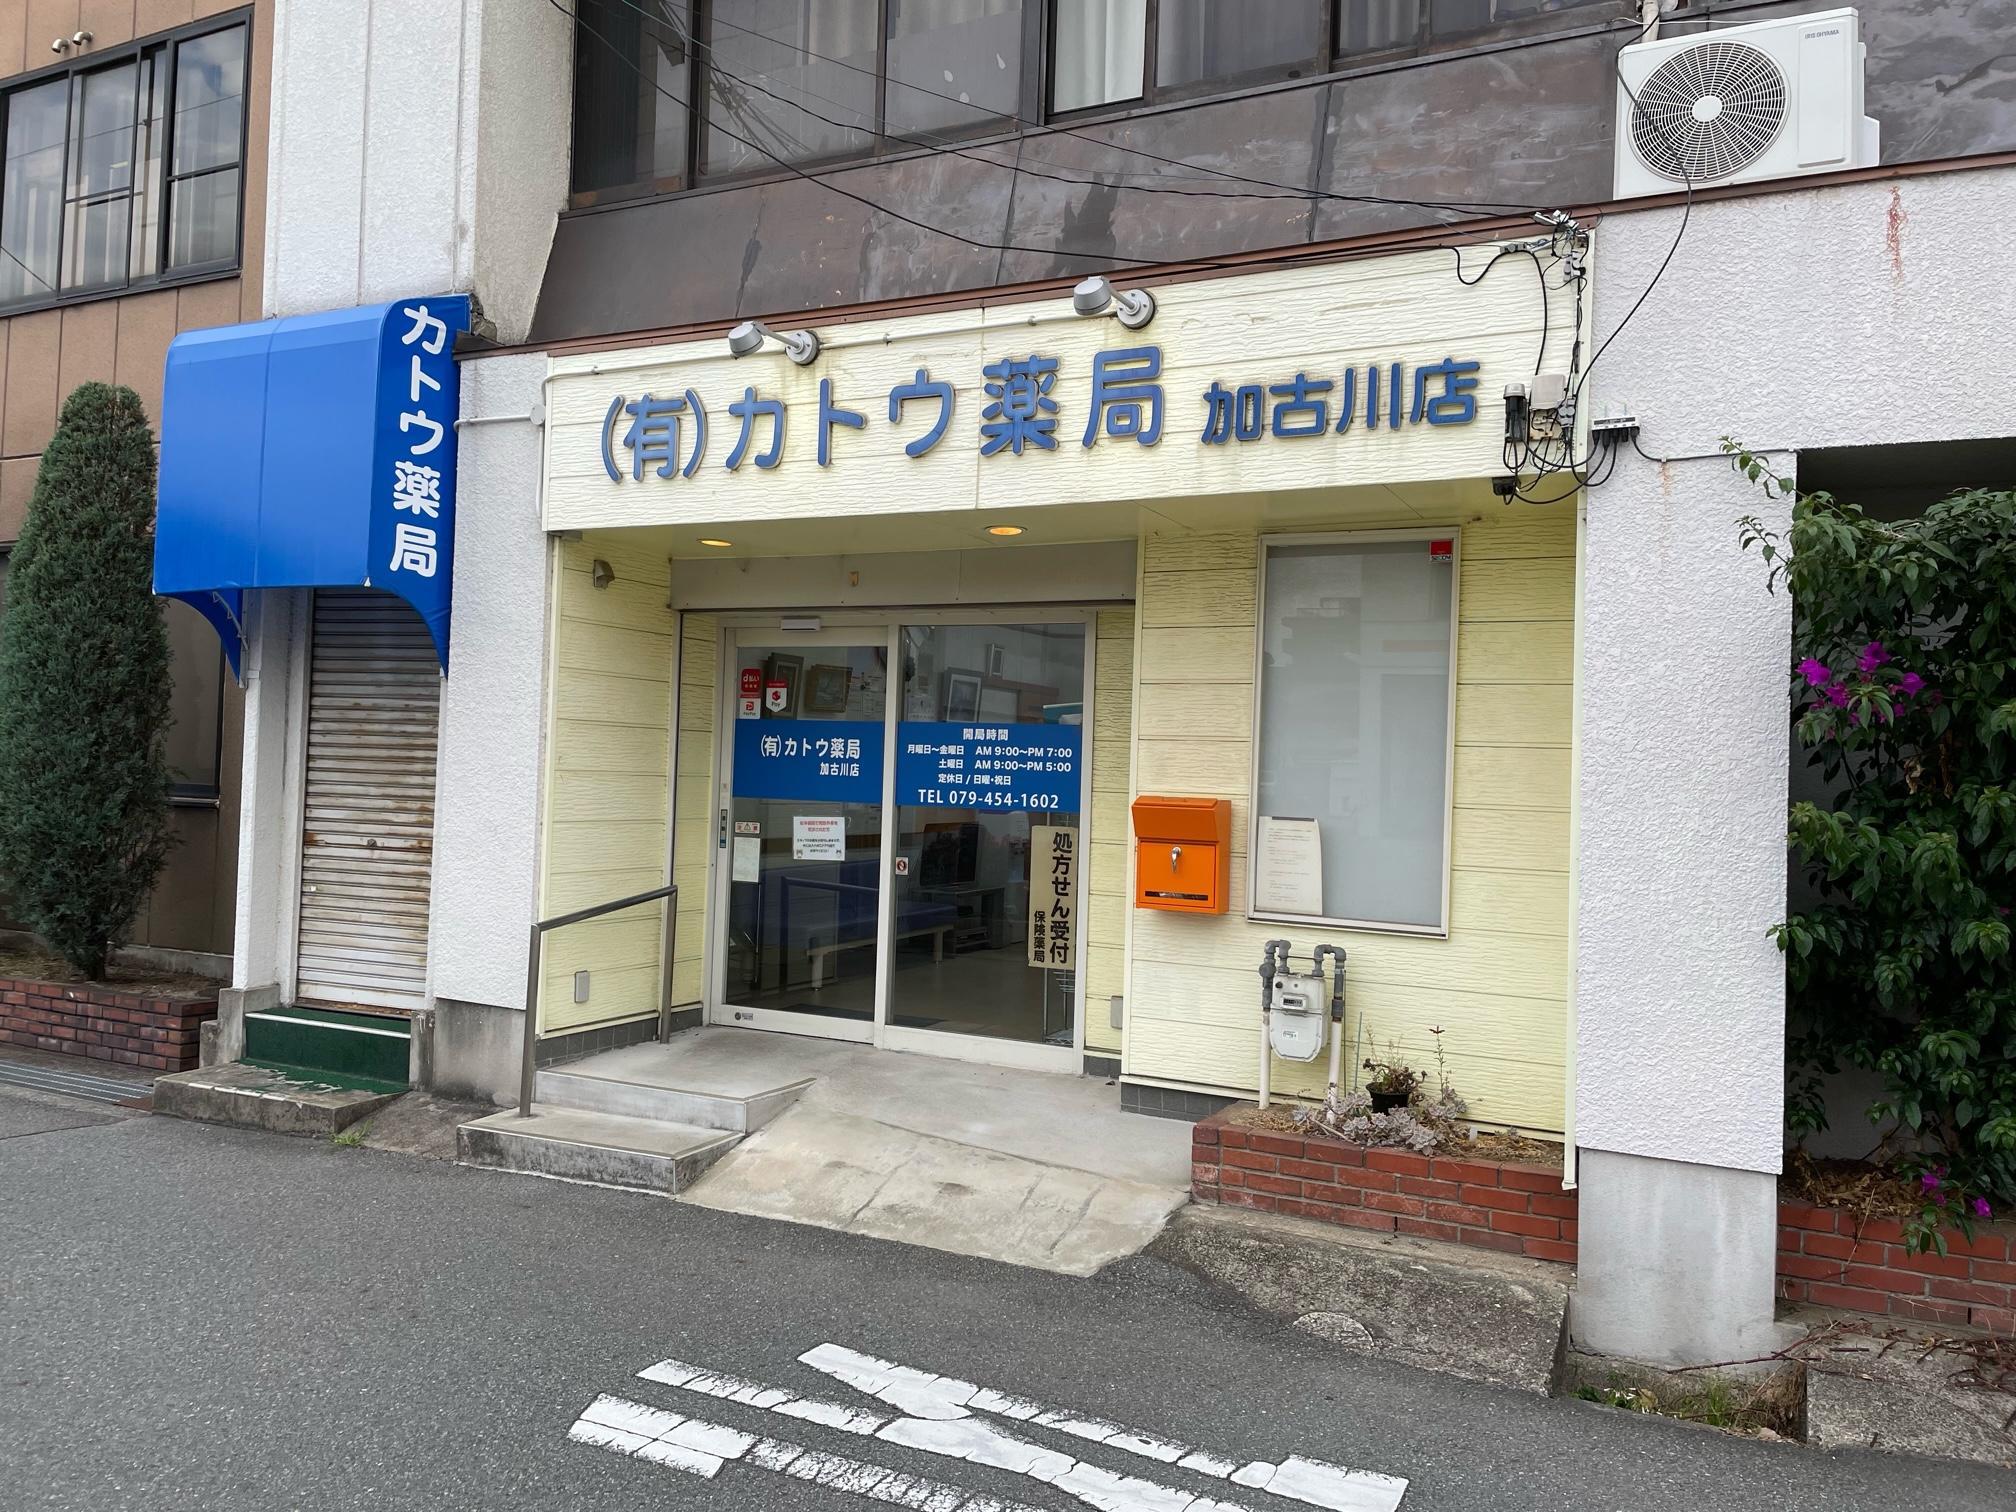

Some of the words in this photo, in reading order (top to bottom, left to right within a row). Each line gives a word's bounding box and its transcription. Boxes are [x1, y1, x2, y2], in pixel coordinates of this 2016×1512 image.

[601, 345, 1164, 483] (有)カトウ薬局
[1201, 357, 1481, 446] 加古川店
[389, 304, 447, 578] カトウ薬局
[962, 728, 1009, 741] 開局時間
[761, 735, 861, 760] (有)カトウ薬局
[907, 744, 965, 755] 月曜日～金曜日
[975, 746, 992, 756] AM
[1046, 748, 1073, 758] 7:00
[819, 762, 860, 777] 加古川店
[938, 758, 964, 769] 土曜日
[974, 760, 991, 769] AM
[1045, 762, 1072, 772] 5:00
[938, 773, 963, 784] 定休日
[918, 788, 944, 804] TEL
[949, 790, 1059, 809] 079-454-1602
[1049, 831, 1073, 964] 処方せん受付
[1033, 910, 1046, 963] 保険薬局
